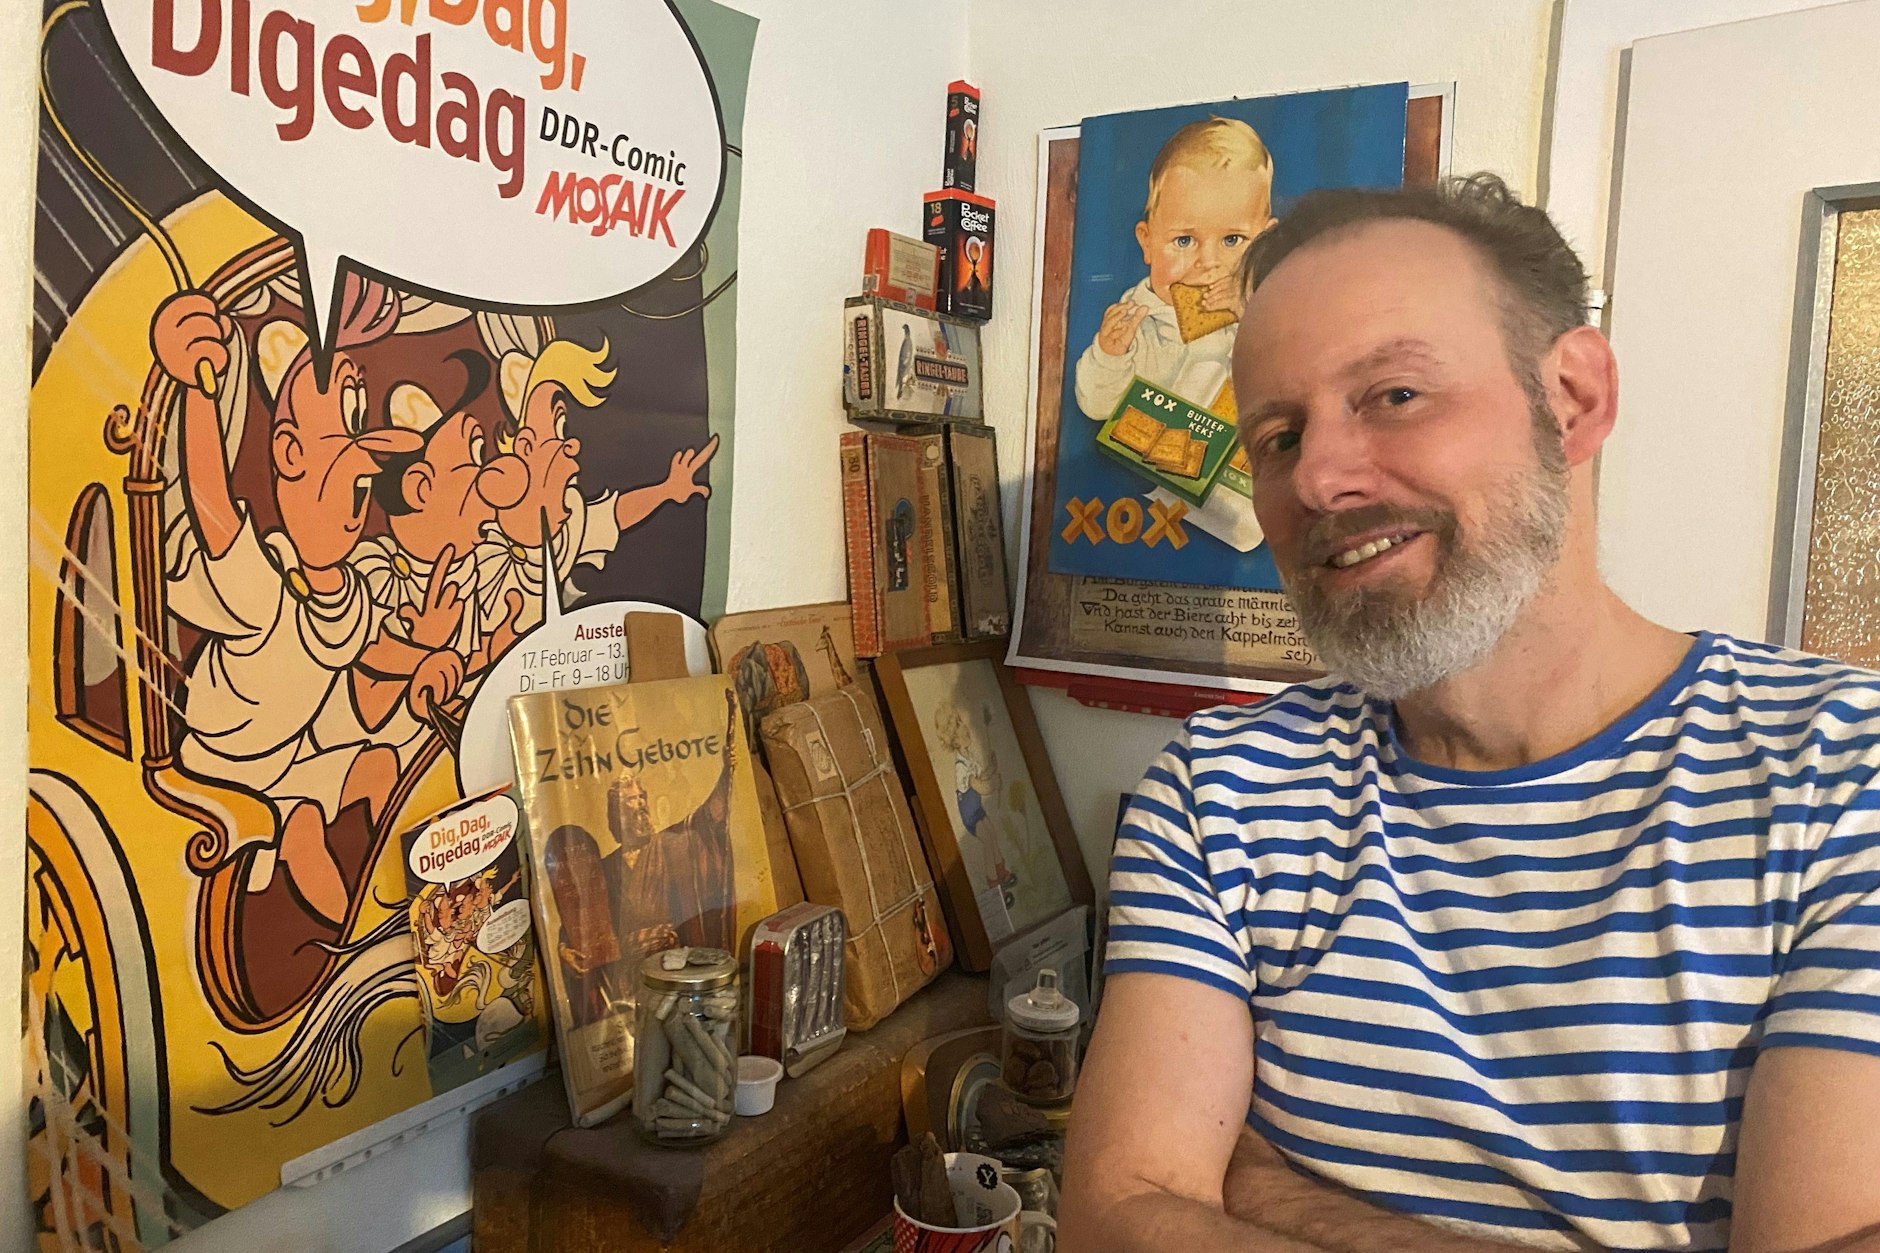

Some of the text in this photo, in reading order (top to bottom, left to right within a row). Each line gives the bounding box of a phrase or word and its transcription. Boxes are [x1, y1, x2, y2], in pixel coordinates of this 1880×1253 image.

[539, 106, 687, 186] DDR-Comic
[535, 170, 687, 248] MOSAIK
[930, 202, 942, 215] 18
[961, 202, 990, 224] Pocket
[960, 217, 988, 233] Coffee
[1141, 387, 1178, 412] XOX
[1188, 421, 1214, 439] KEKS
[1060, 495, 1191, 551] XOX
[1102, 587, 1129, 603] Da
[1131, 590, 1162, 607] geht
[1164, 592, 1190, 606] das
[1115, 605, 1145, 620] hast
[1147, 607, 1171, 620] der
[1172, 607, 1212, 623] Biere
[1214, 611, 1247, 629] acht
[1251, 613, 1272, 628] bis
[1104, 619, 1152, 636] Kannst
[1190, 626, 1215, 641] den
[540, 649, 594, 668] Februar
[419, 838, 481, 875] Digedag
